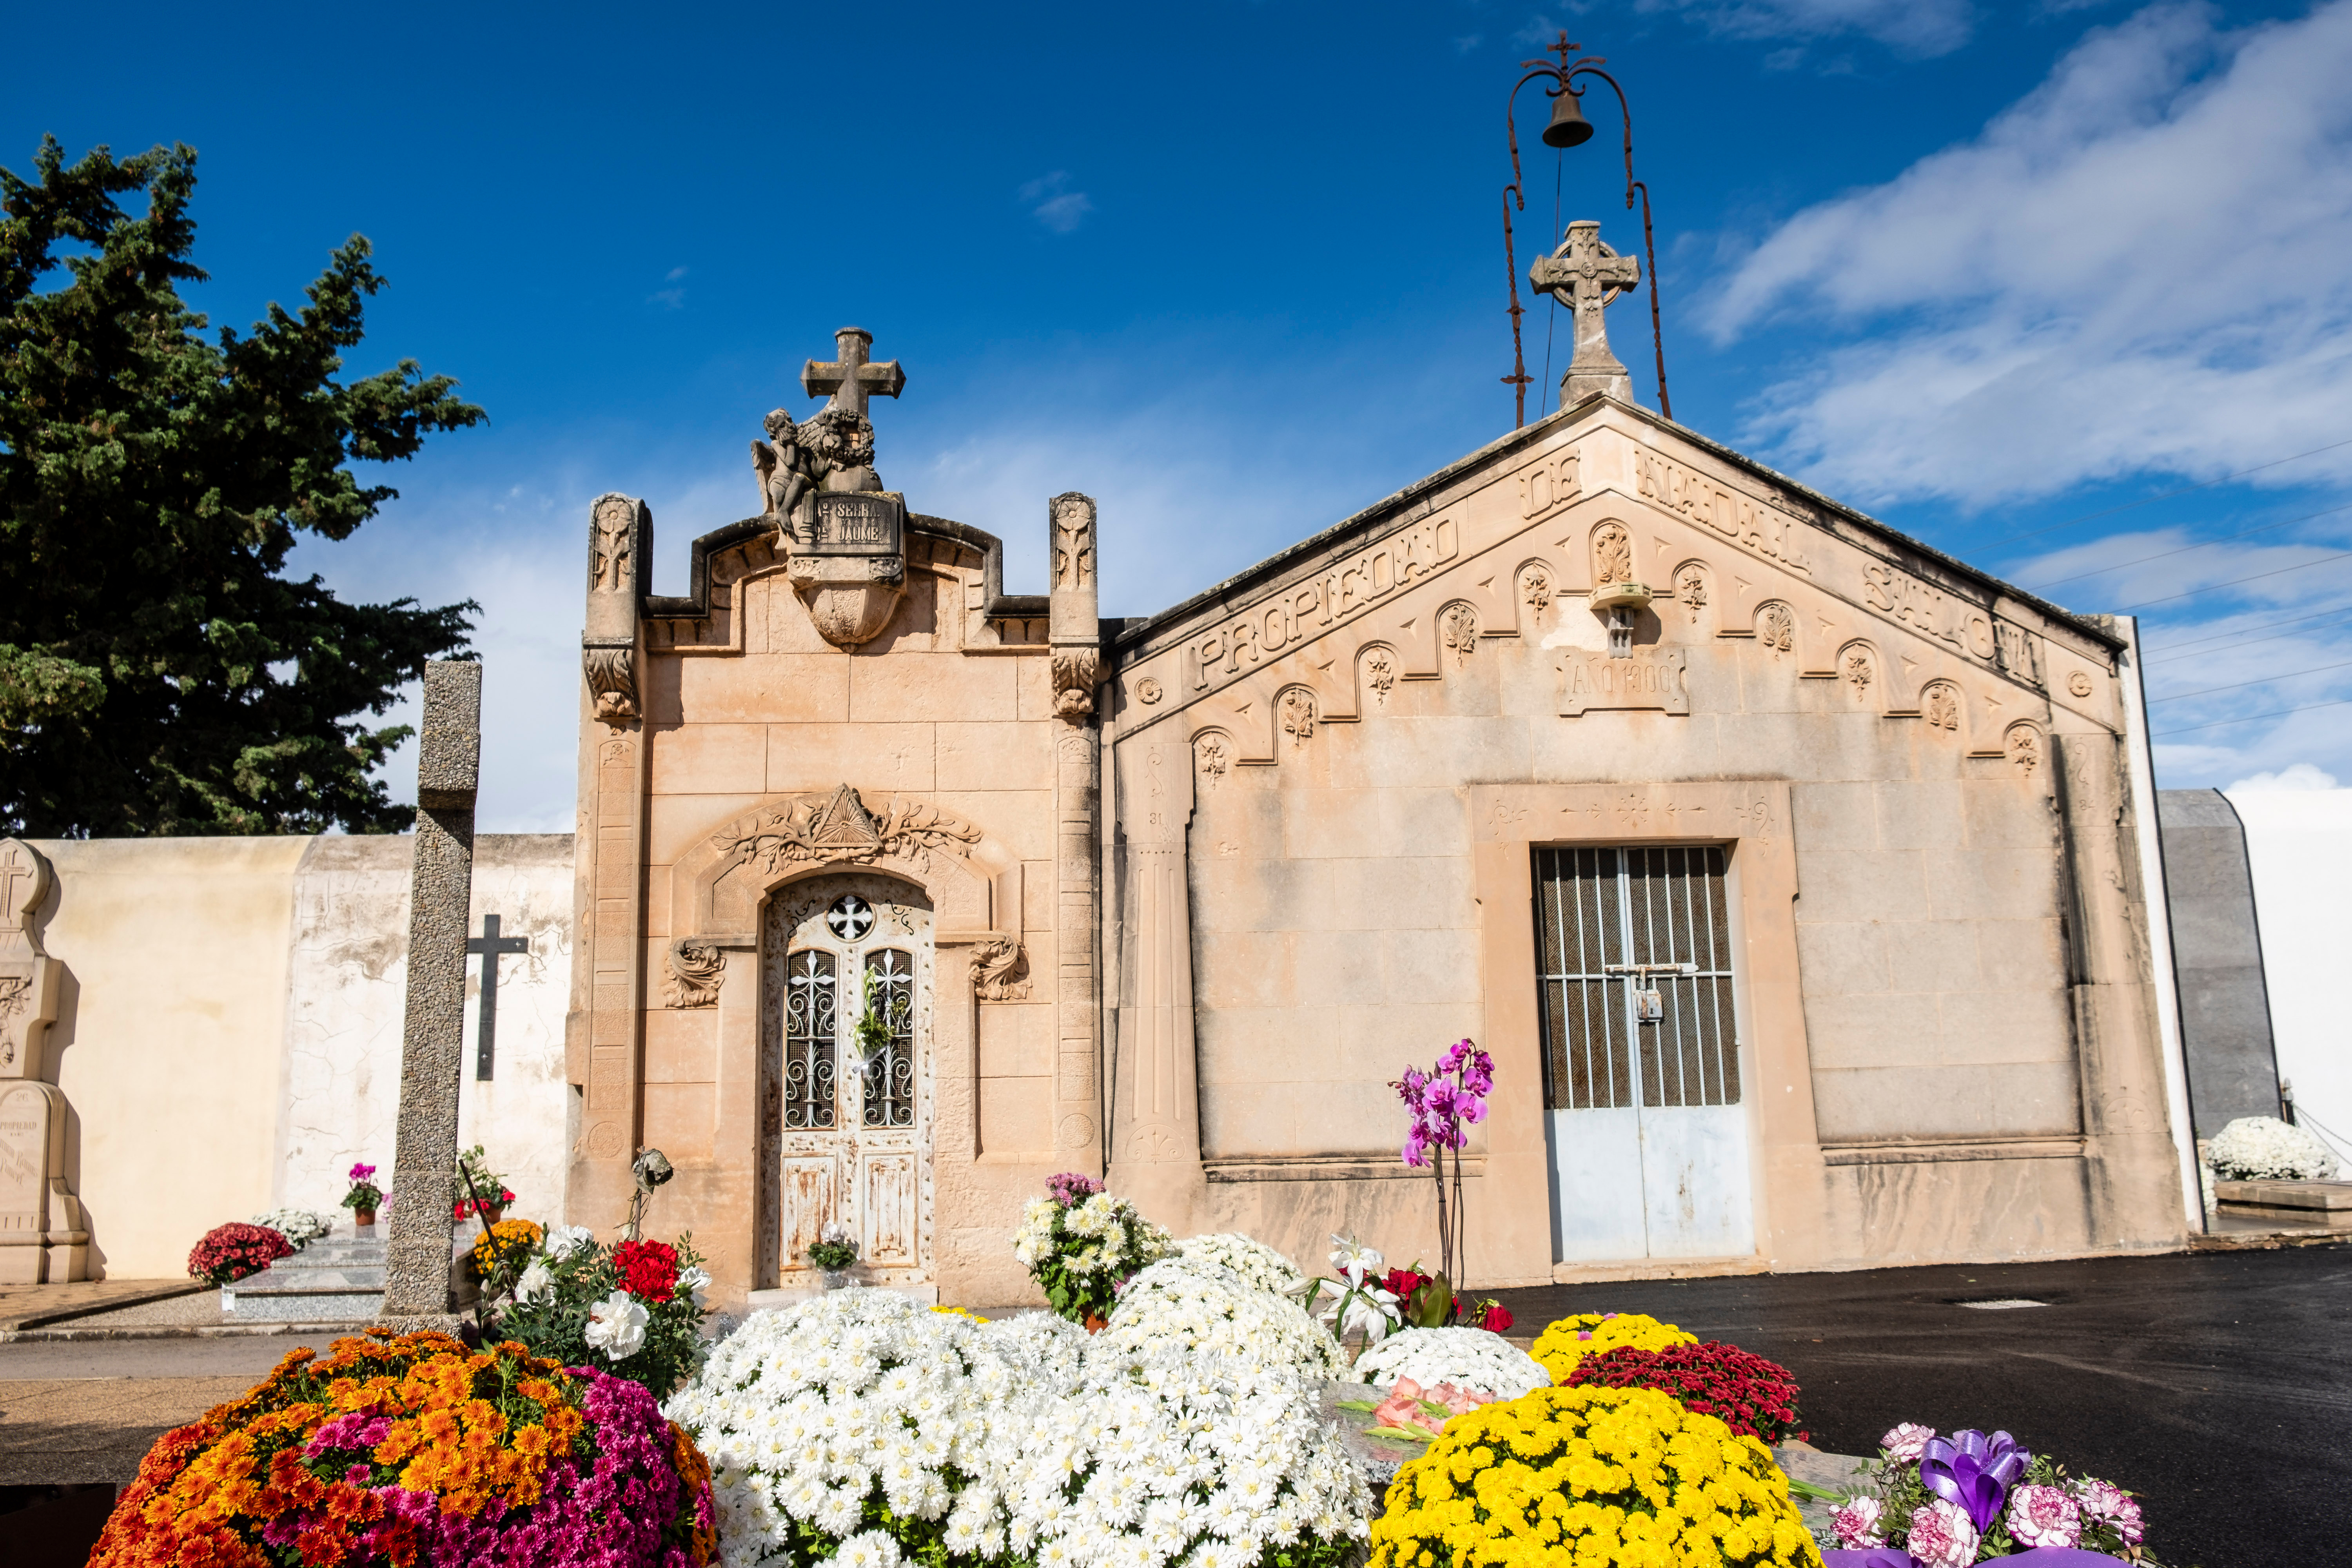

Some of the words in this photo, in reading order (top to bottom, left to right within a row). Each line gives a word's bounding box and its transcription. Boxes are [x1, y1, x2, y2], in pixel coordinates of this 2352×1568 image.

[1190, 517, 1459, 691] PROPIEDAD
[1519, 446, 1582, 520] DE
[1635, 448, 1812, 575] NADAL
[1573, 657, 1613, 693] AÑO
[1622, 665, 1670, 693] 1900
